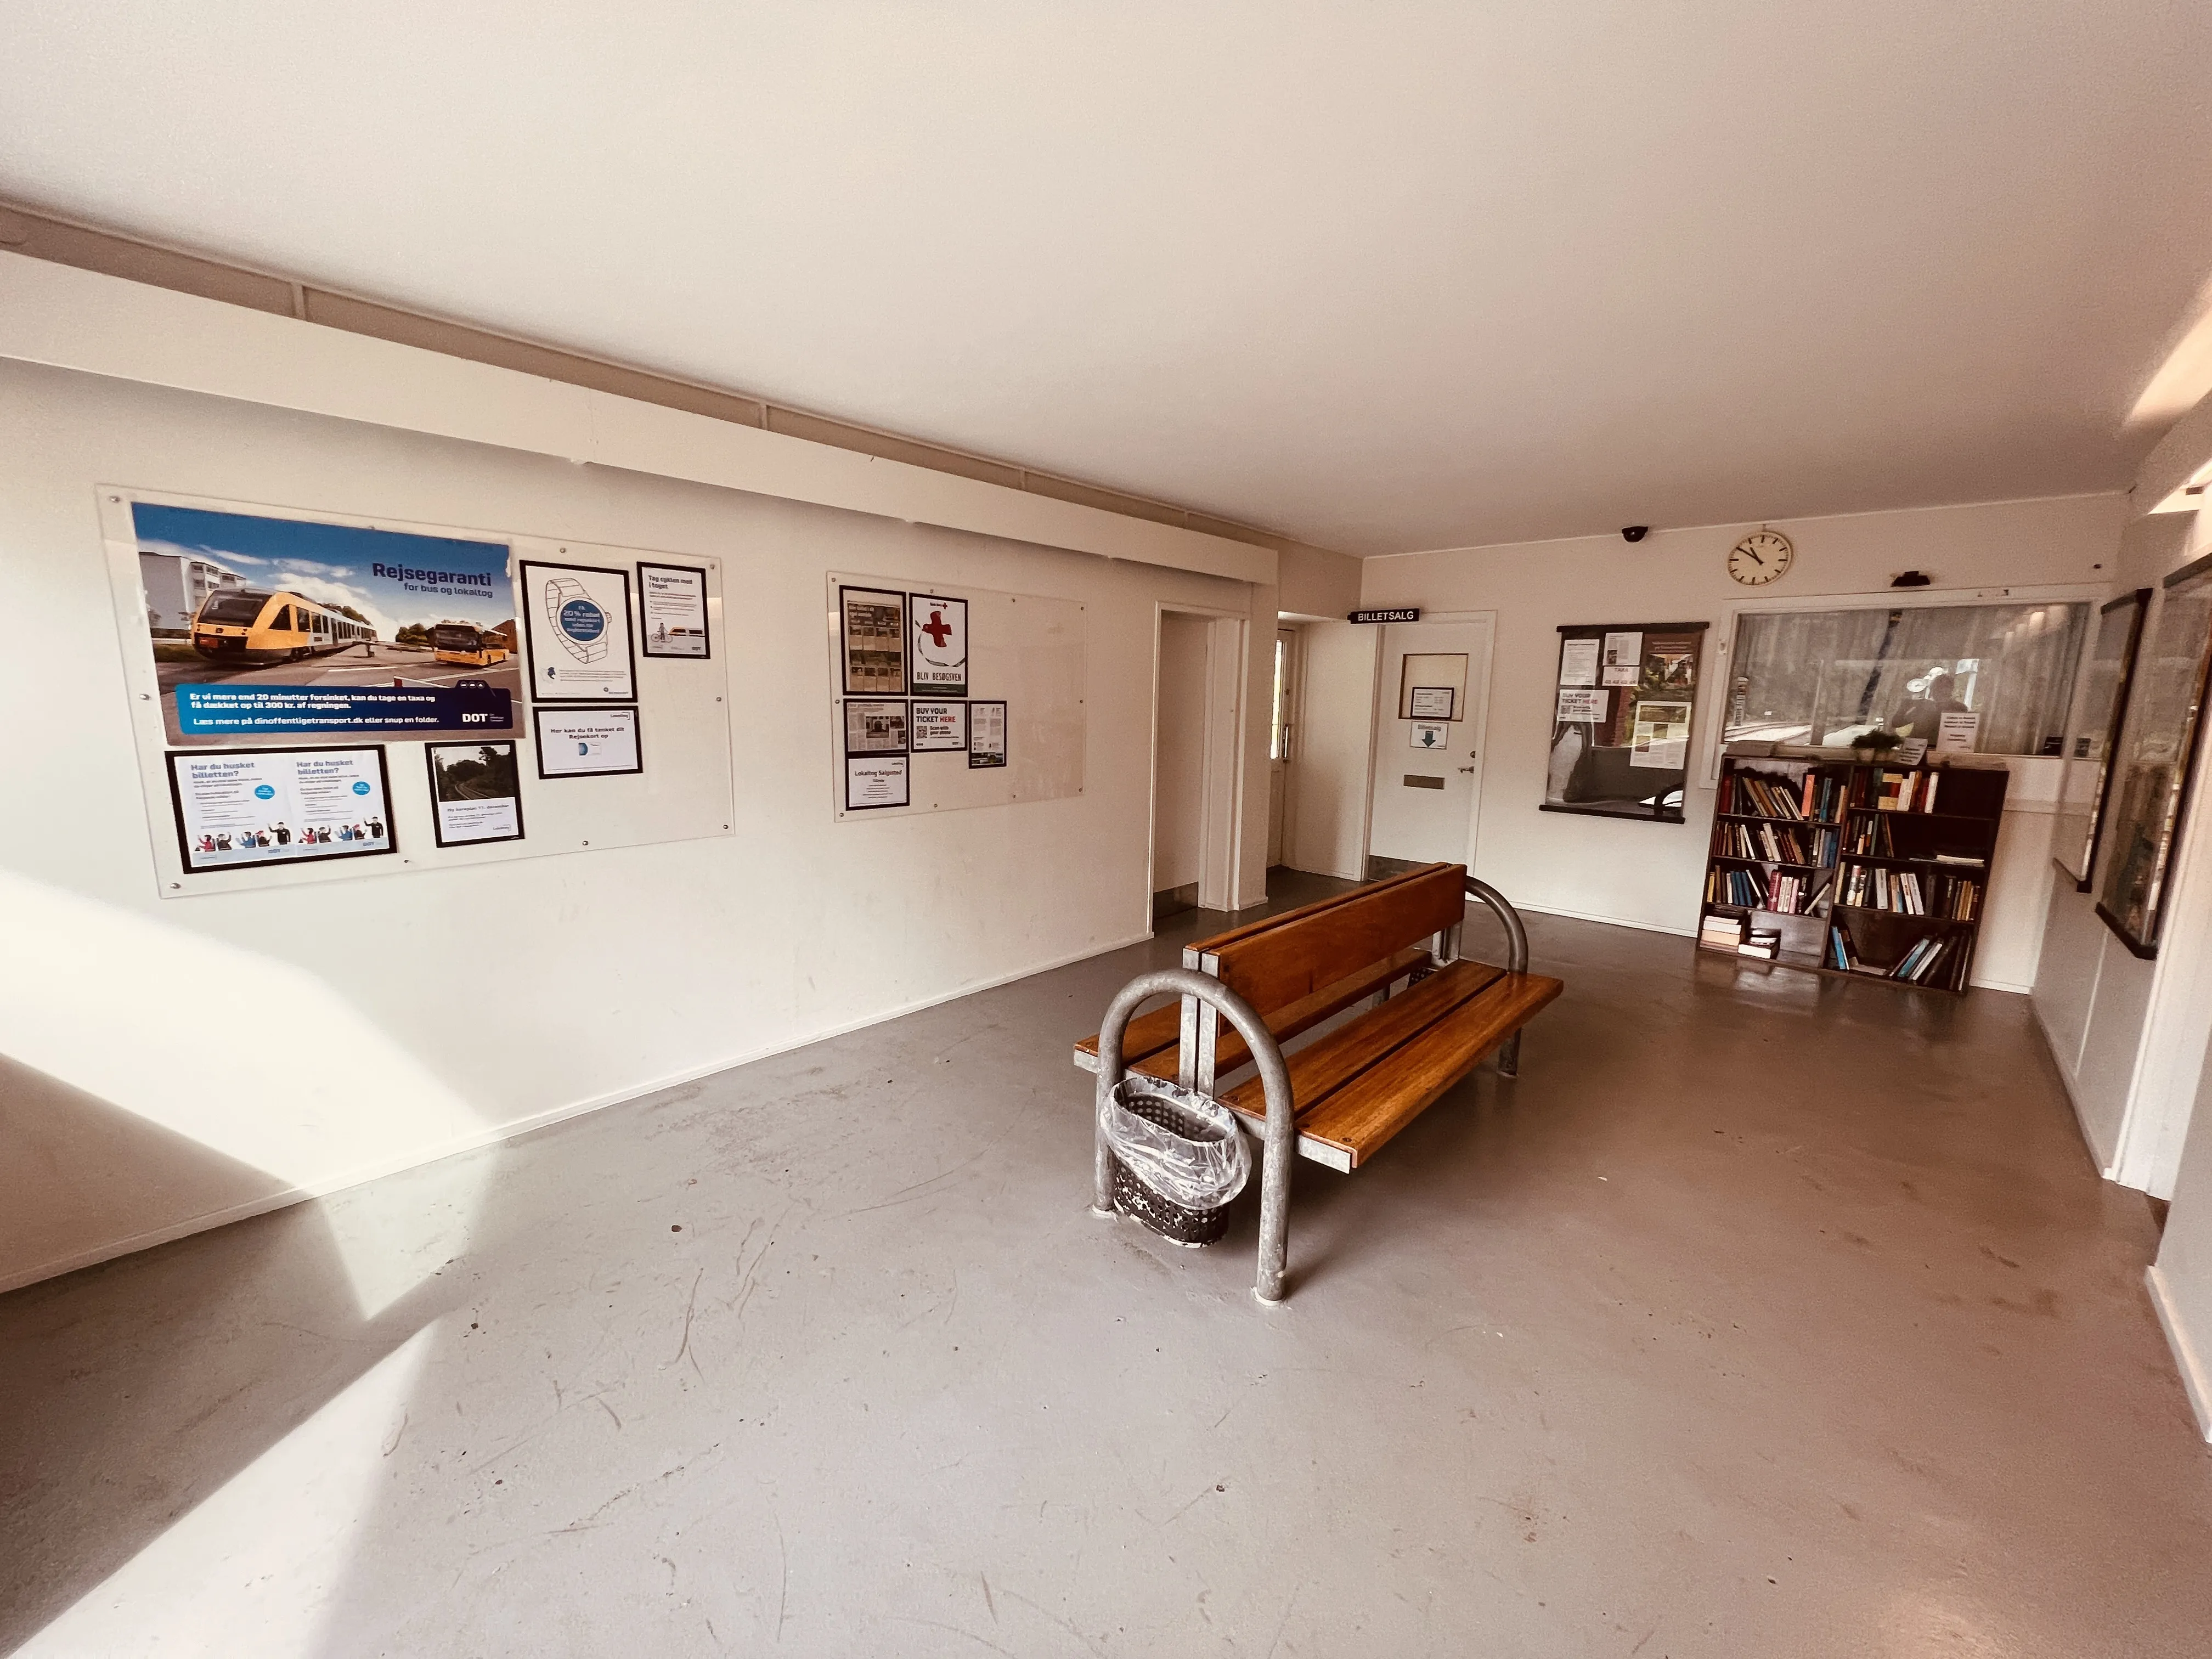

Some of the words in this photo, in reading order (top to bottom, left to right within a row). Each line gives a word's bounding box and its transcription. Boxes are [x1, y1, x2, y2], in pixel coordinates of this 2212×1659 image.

[373, 562, 492, 586] Rejsegaranti
[441, 587, 452, 595] og
[454, 588, 493, 598] lokaltog
[1358, 611, 1414, 622] BILLETSALG
[933, 673, 962, 681] BESØGSVEN
[241, 718, 252, 726] på
[254, 717, 363, 726] dinoffentligetransport.dk
[462, 713, 488, 723] DOT
